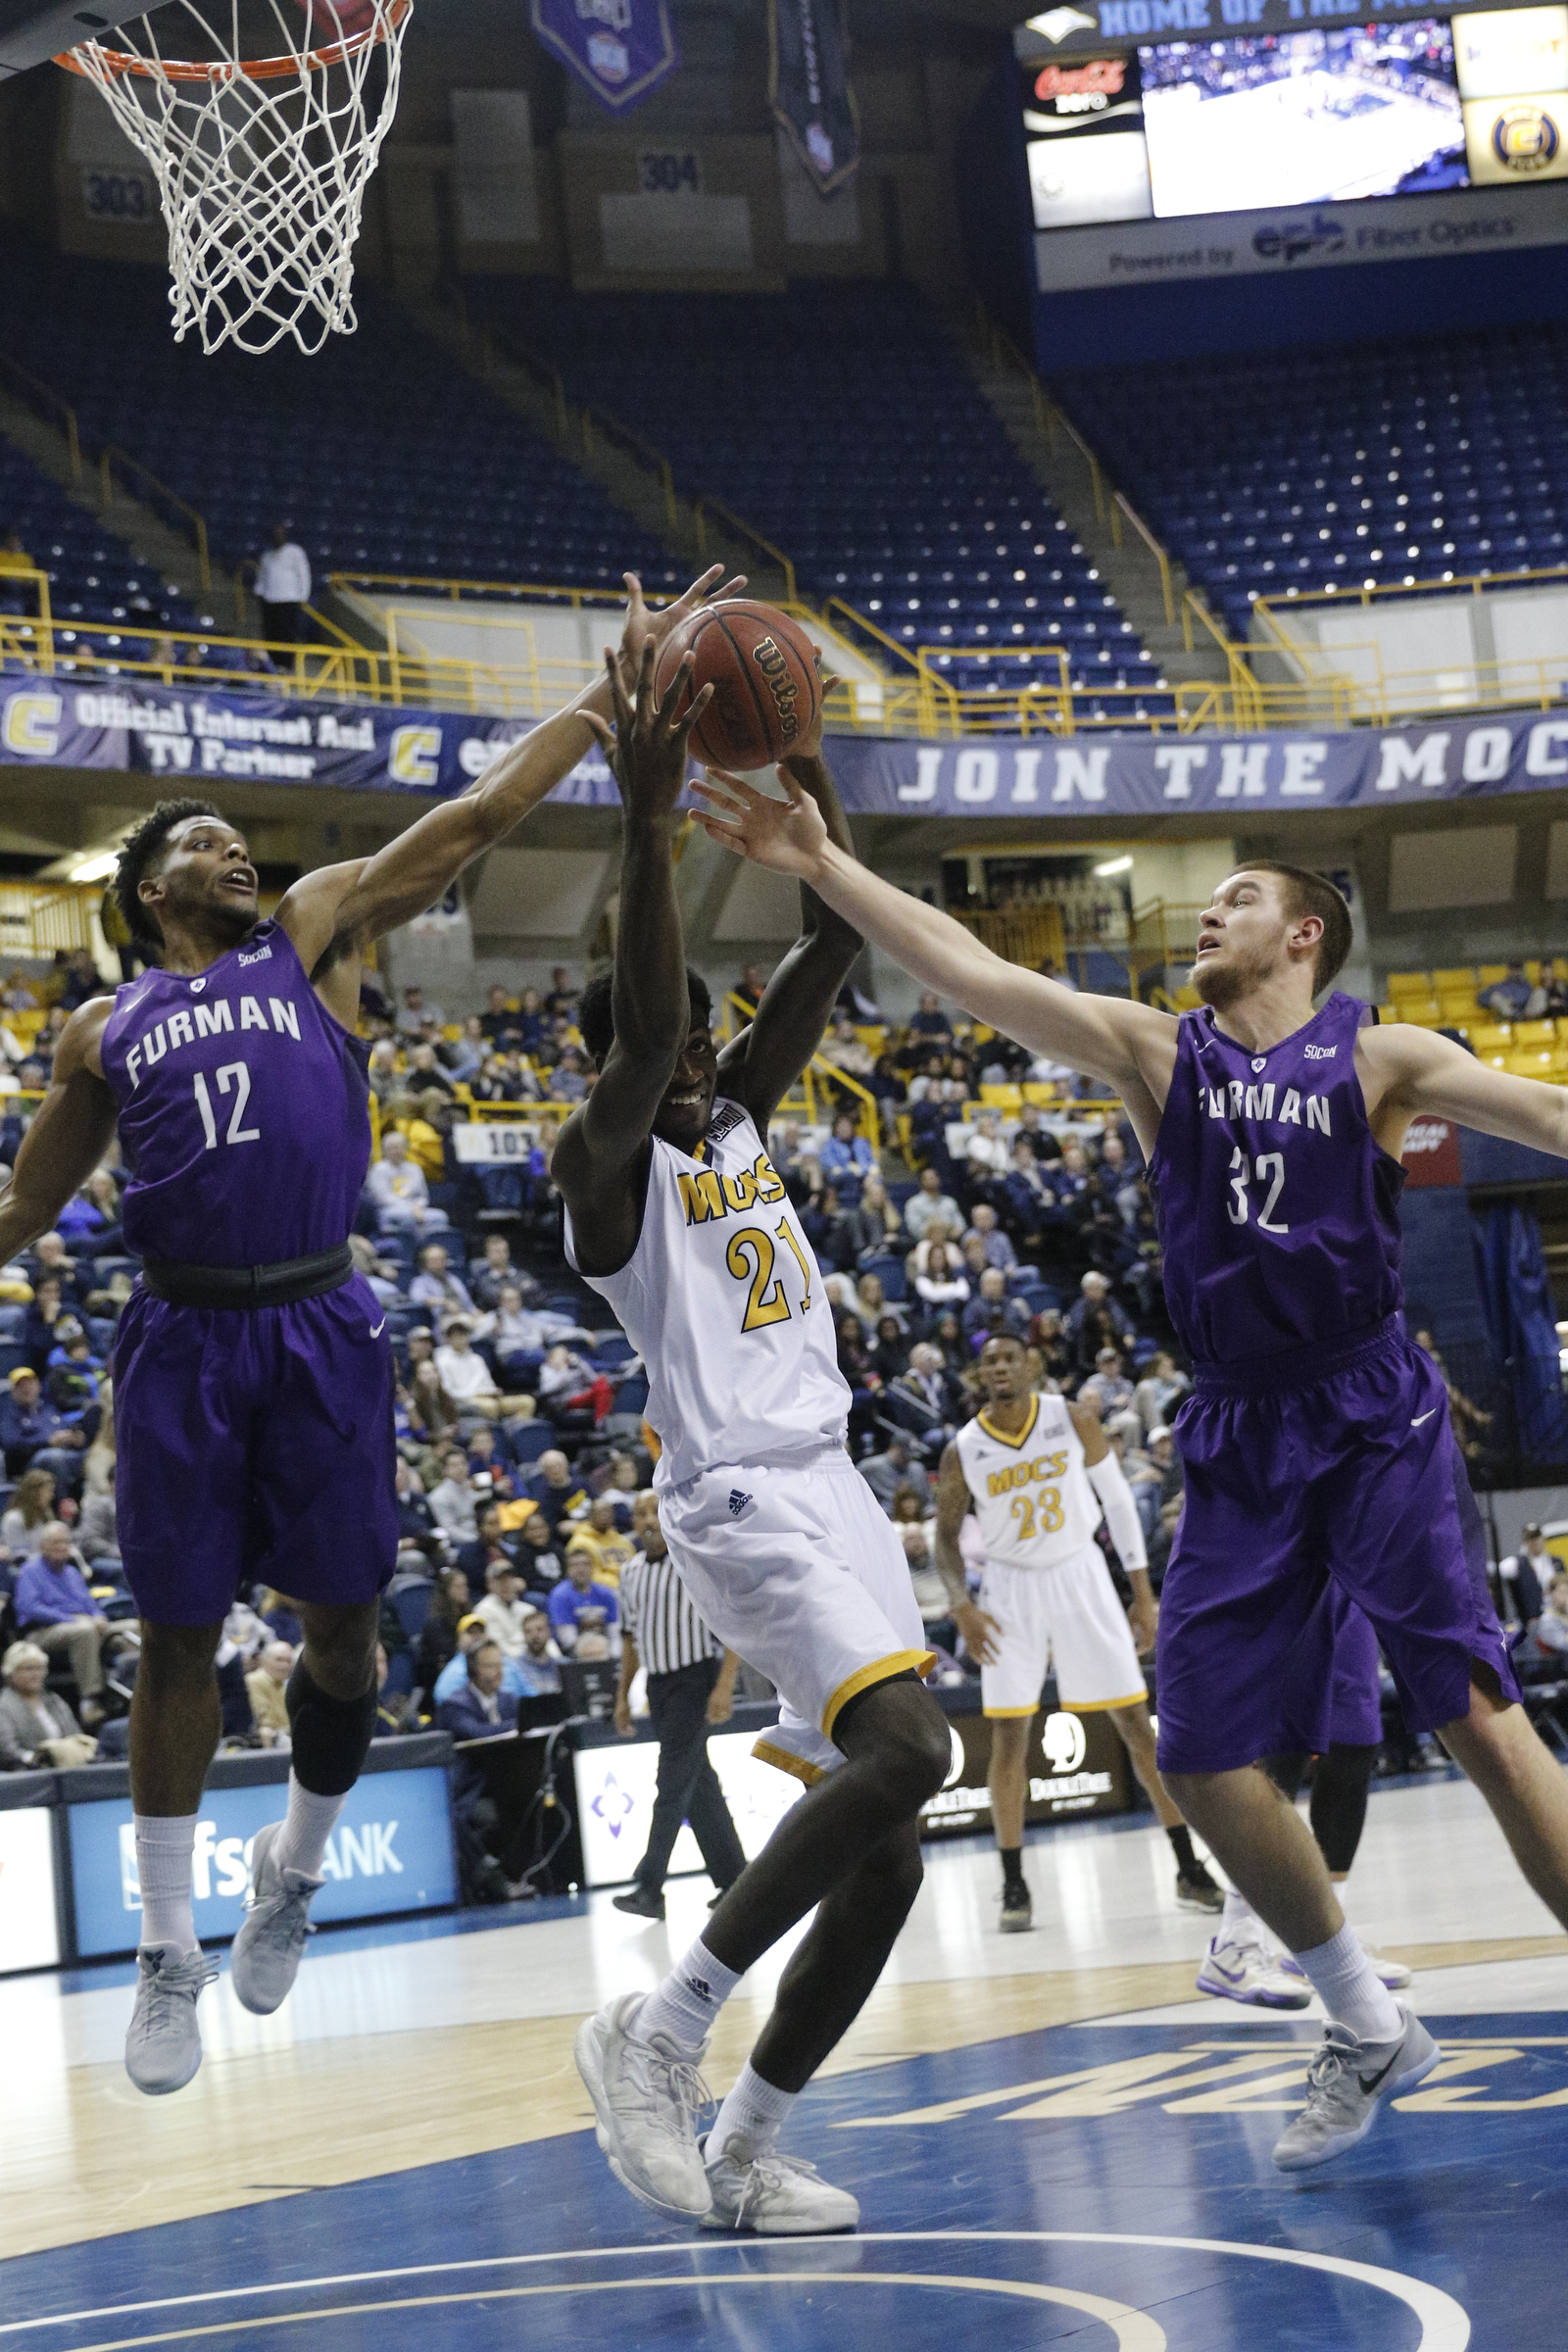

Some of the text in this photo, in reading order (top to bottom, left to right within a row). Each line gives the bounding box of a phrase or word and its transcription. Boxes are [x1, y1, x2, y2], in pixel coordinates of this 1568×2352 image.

[1099, 0, 1210, 37] HOME
[1109, 249, 1203, 273] Powered
[1207, 247, 1235, 269] by
[75, 693, 376, 751] Official Internet And
[145, 733, 317, 779] TV Partner
[897, 720, 1568, 803] JOIN THE MOC
[125, 996, 302, 1090] FURMAN
[193, 1060, 261, 1150] 12
[1226, 1146, 1290, 1234] 32
[725, 1215, 811, 1334] 21
[987, 1450, 1068, 1498] MOCS
[1010, 1487, 1064, 1542] 23
